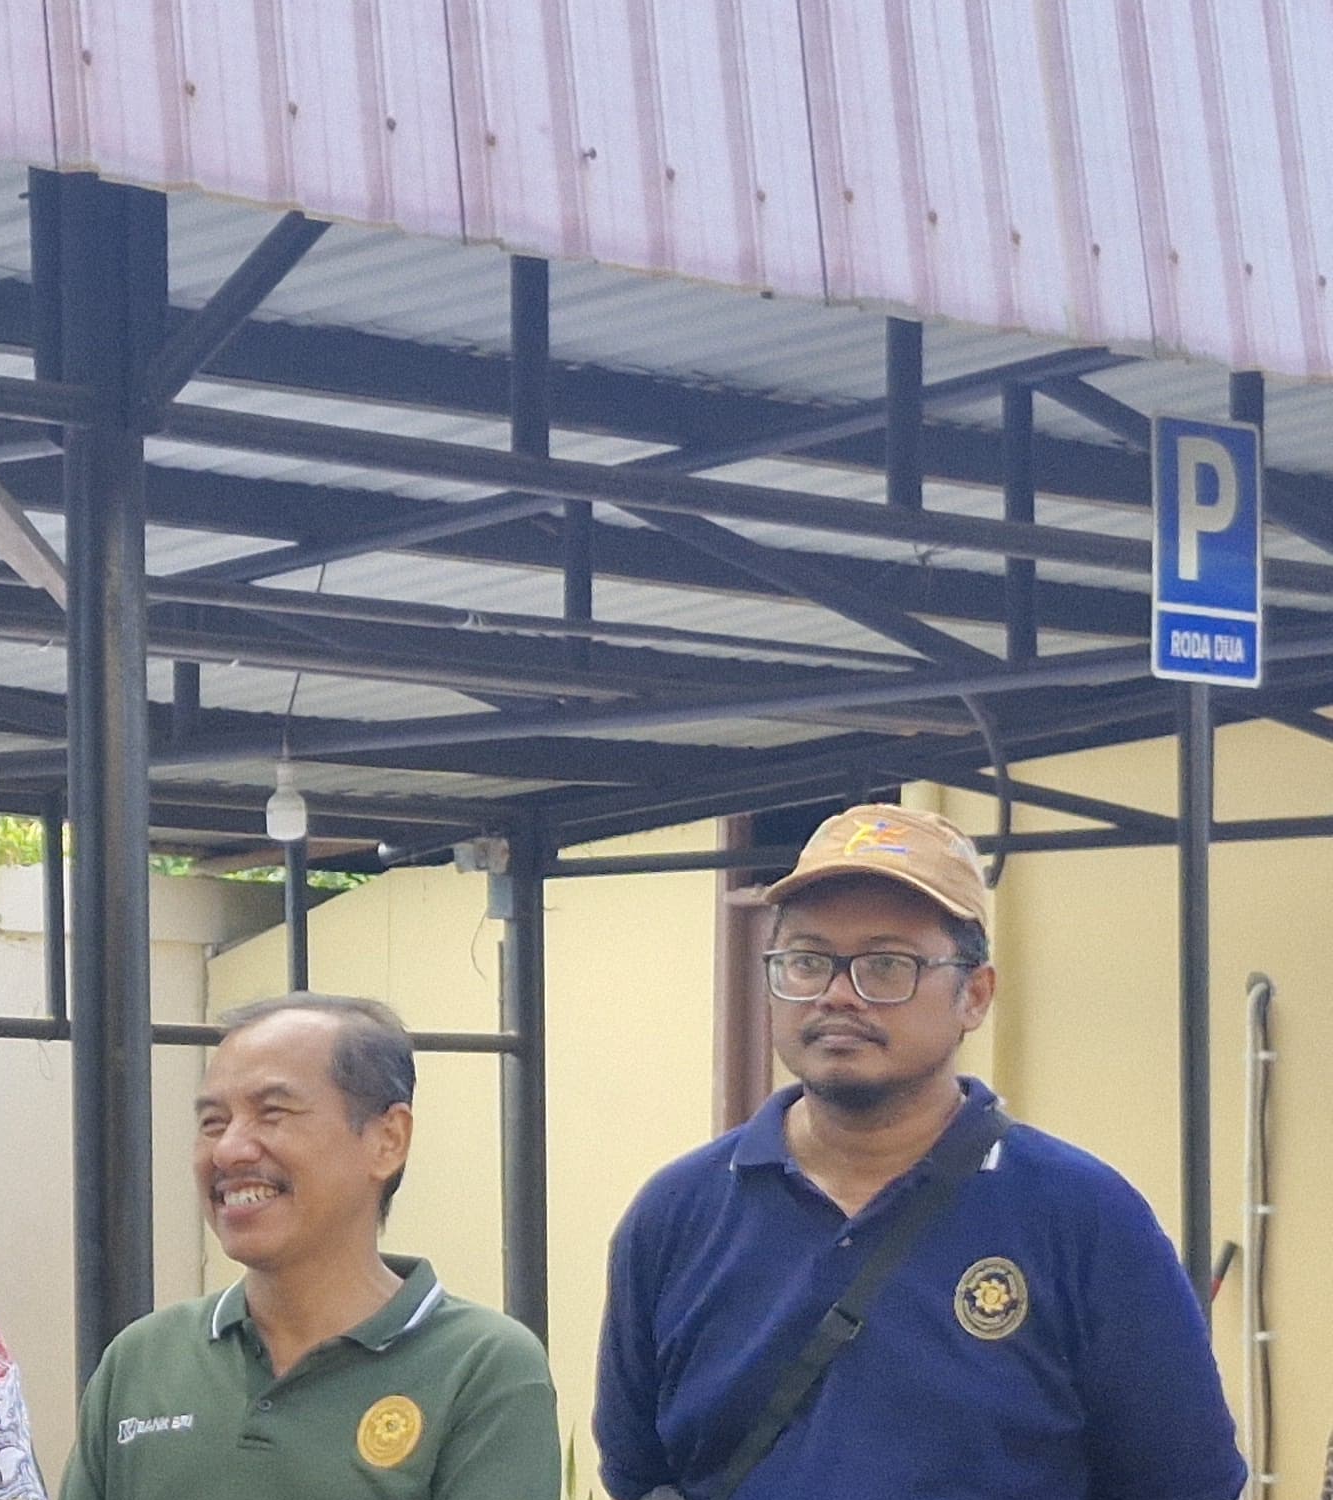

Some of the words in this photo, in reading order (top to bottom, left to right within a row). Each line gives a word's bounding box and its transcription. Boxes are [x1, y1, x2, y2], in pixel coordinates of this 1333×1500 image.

[1177, 436, 1236, 581] P
[1170, 629, 1211, 660] RODA
[1214, 633, 1245, 663] DUA
